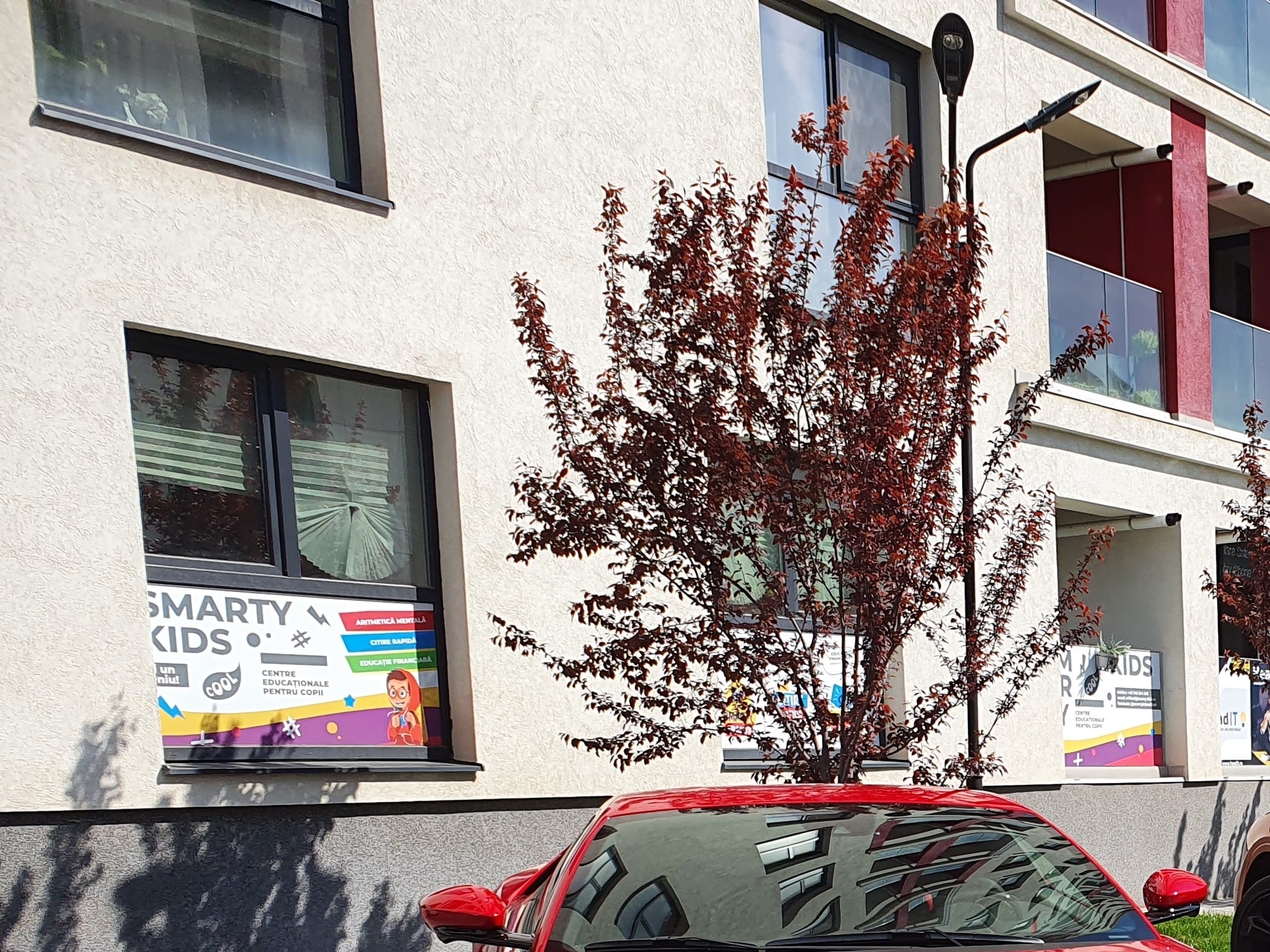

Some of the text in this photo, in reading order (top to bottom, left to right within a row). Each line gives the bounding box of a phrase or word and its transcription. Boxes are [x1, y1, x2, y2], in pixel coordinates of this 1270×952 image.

[148, 591, 292, 626] SMARTY
[370, 638, 391, 646] CITIRE
[205, 673, 239, 697] COOL
